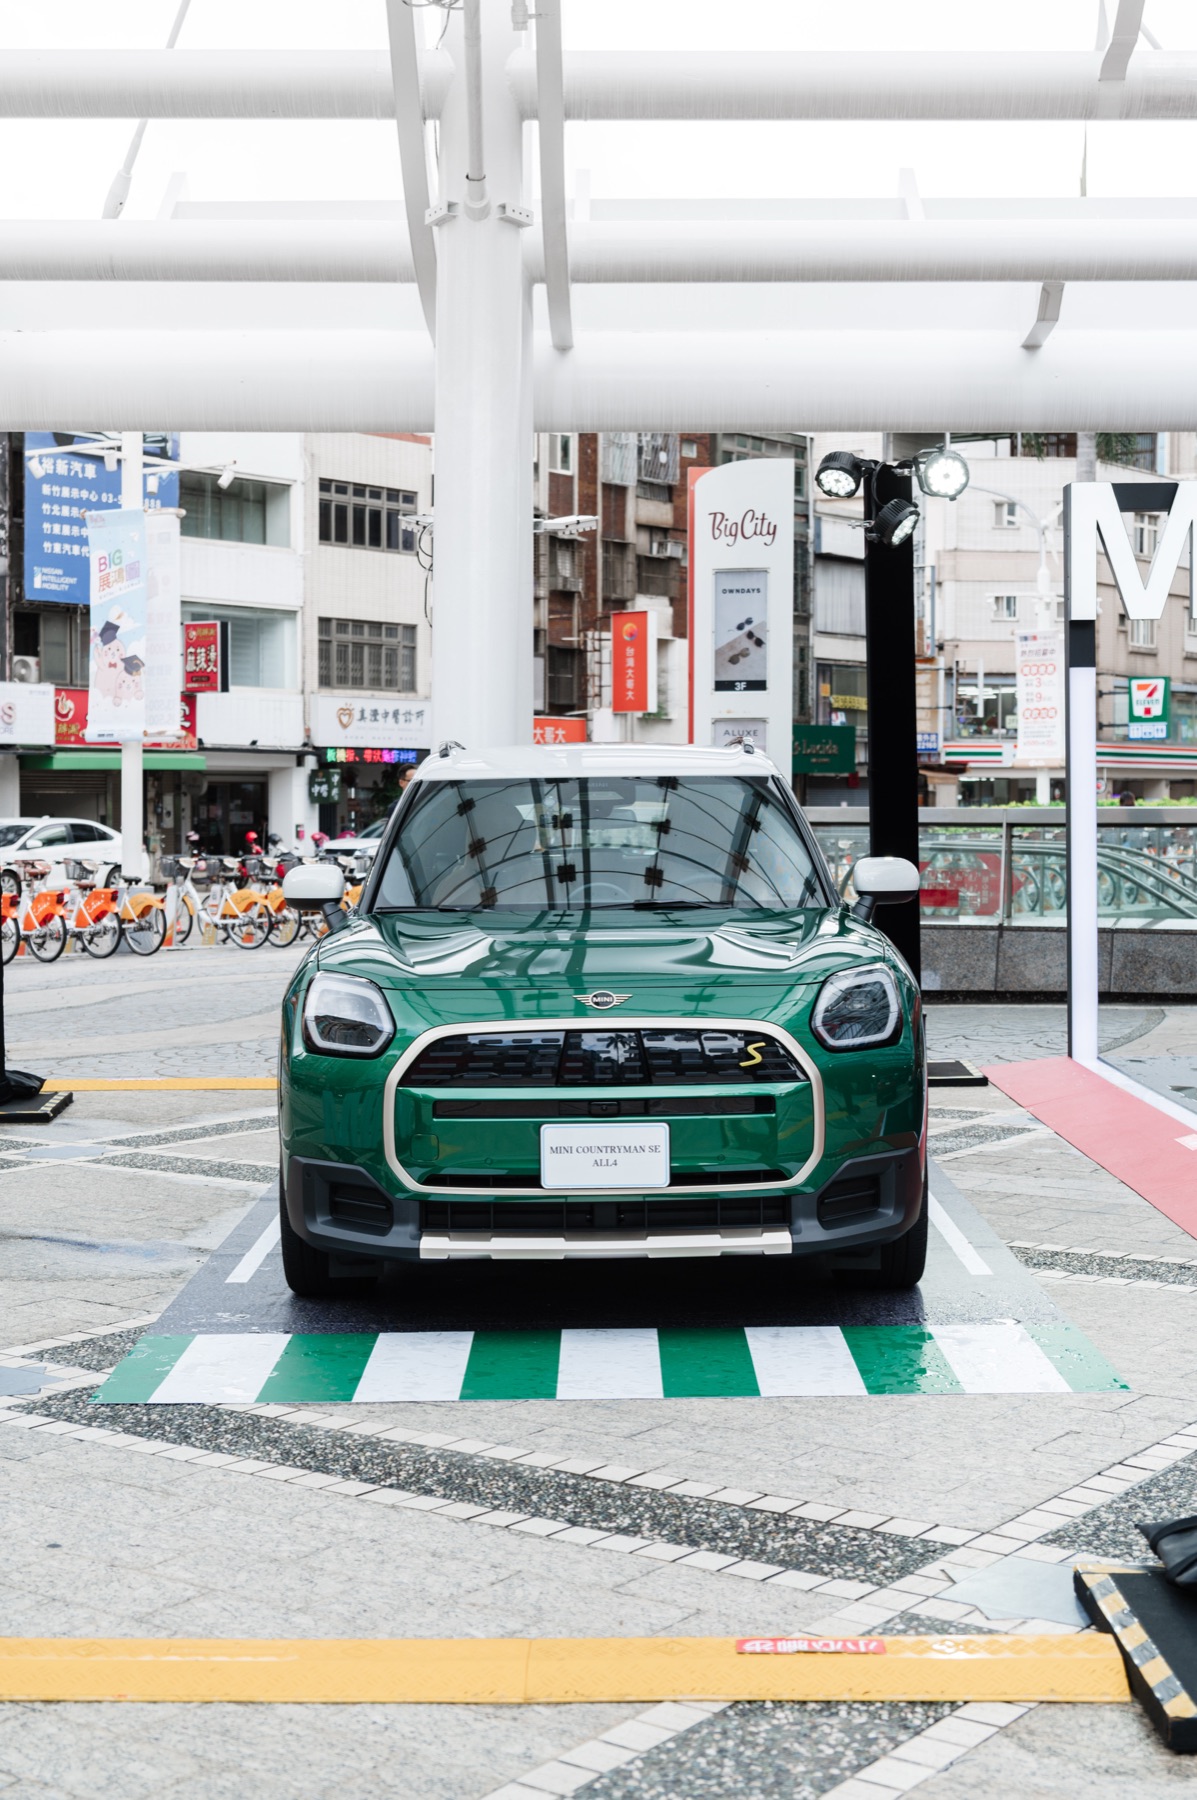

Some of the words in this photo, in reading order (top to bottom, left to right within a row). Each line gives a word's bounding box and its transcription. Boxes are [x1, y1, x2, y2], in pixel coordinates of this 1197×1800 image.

[98, 549, 123, 573] BIG
[722, 587, 761, 595] OWNDAYS
[734, 682, 748, 691] 3F
[533, 726, 566, 744] 大哥大
[723, 729, 759, 737] ALUXE
[550, 1146, 573, 1155] MINI
[576, 1145, 646, 1154] COUNTRYMAN
[648, 1145, 660, 1153] SE
[592, 1159, 618, 1167] ALL4
